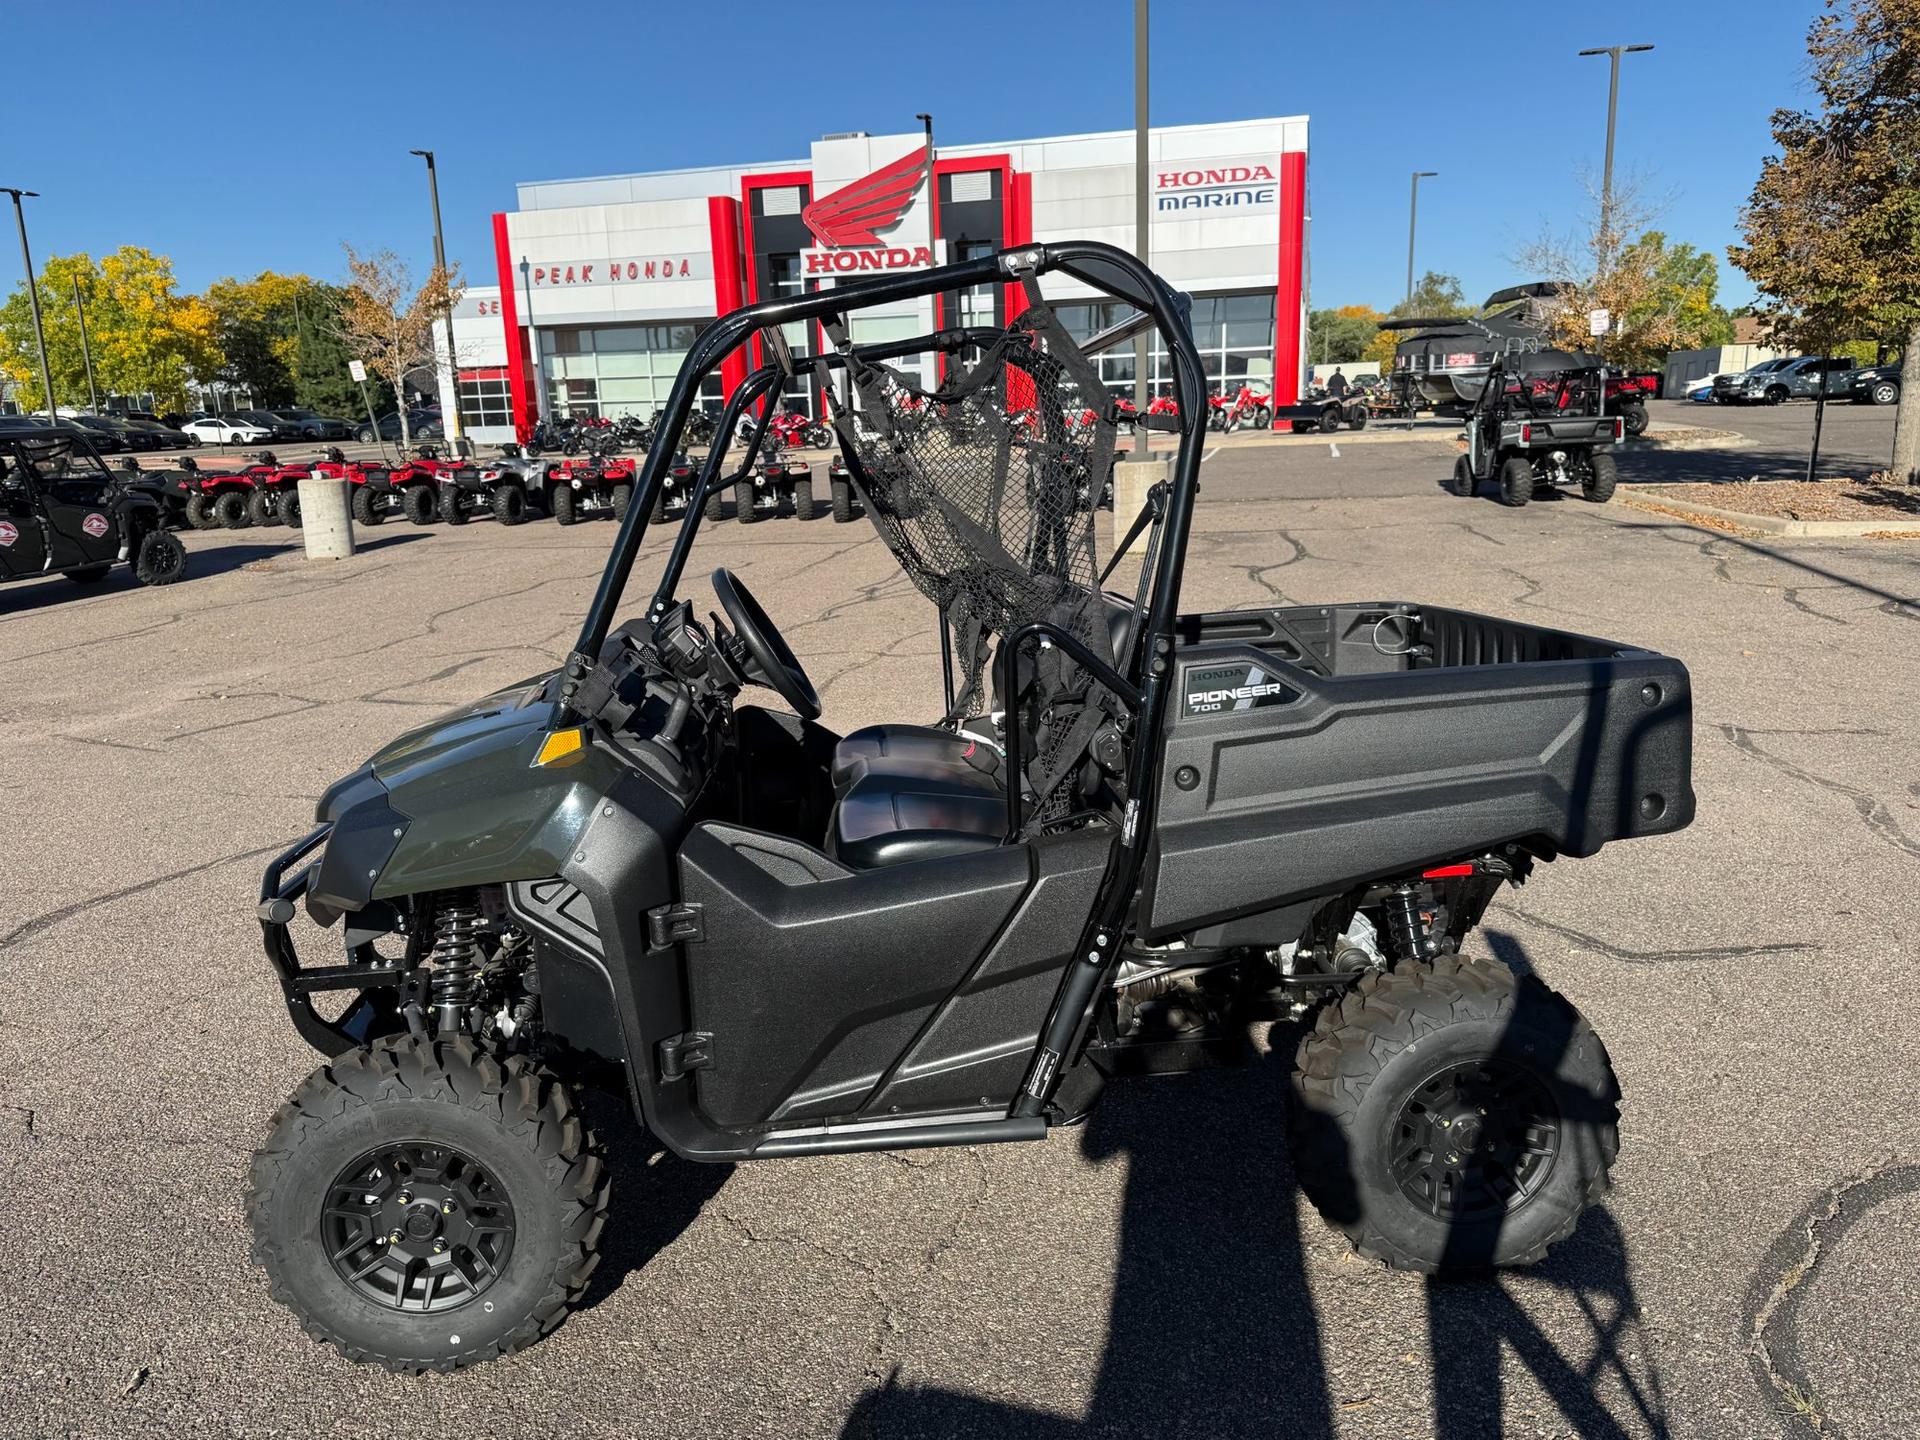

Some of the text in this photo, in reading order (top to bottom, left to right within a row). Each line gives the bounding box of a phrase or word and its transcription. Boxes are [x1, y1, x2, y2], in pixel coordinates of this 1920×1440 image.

[1158, 166, 1275, 187] HONDA
[806, 246, 938, 273] HONDA
[534, 259, 690, 286] PEAK HONDA
[1191, 669, 1245, 681] HONDA
[1188, 683, 1280, 704] PIONEER
[1190, 703, 1221, 712] 700
